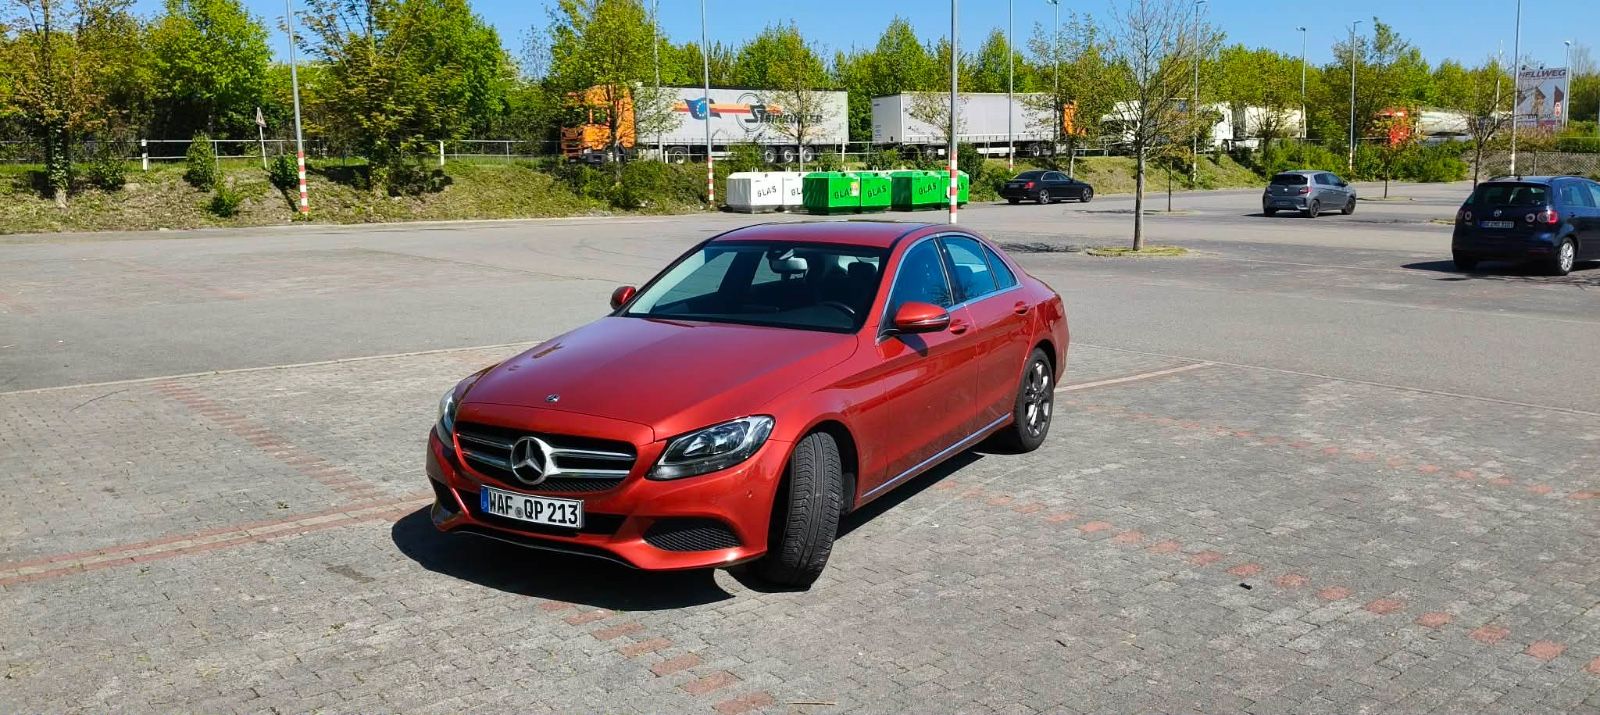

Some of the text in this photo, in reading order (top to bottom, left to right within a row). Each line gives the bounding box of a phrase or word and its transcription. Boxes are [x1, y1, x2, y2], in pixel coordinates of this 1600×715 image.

[1519, 69, 1566, 78] HELLWEG
[757, 185, 776, 198] GLAS
[790, 187, 803, 196] GL
[867, 184, 887, 198] GLAS
[918, 182, 937, 195] GLAS
[489, 491, 578, 525] WAF QP 213
